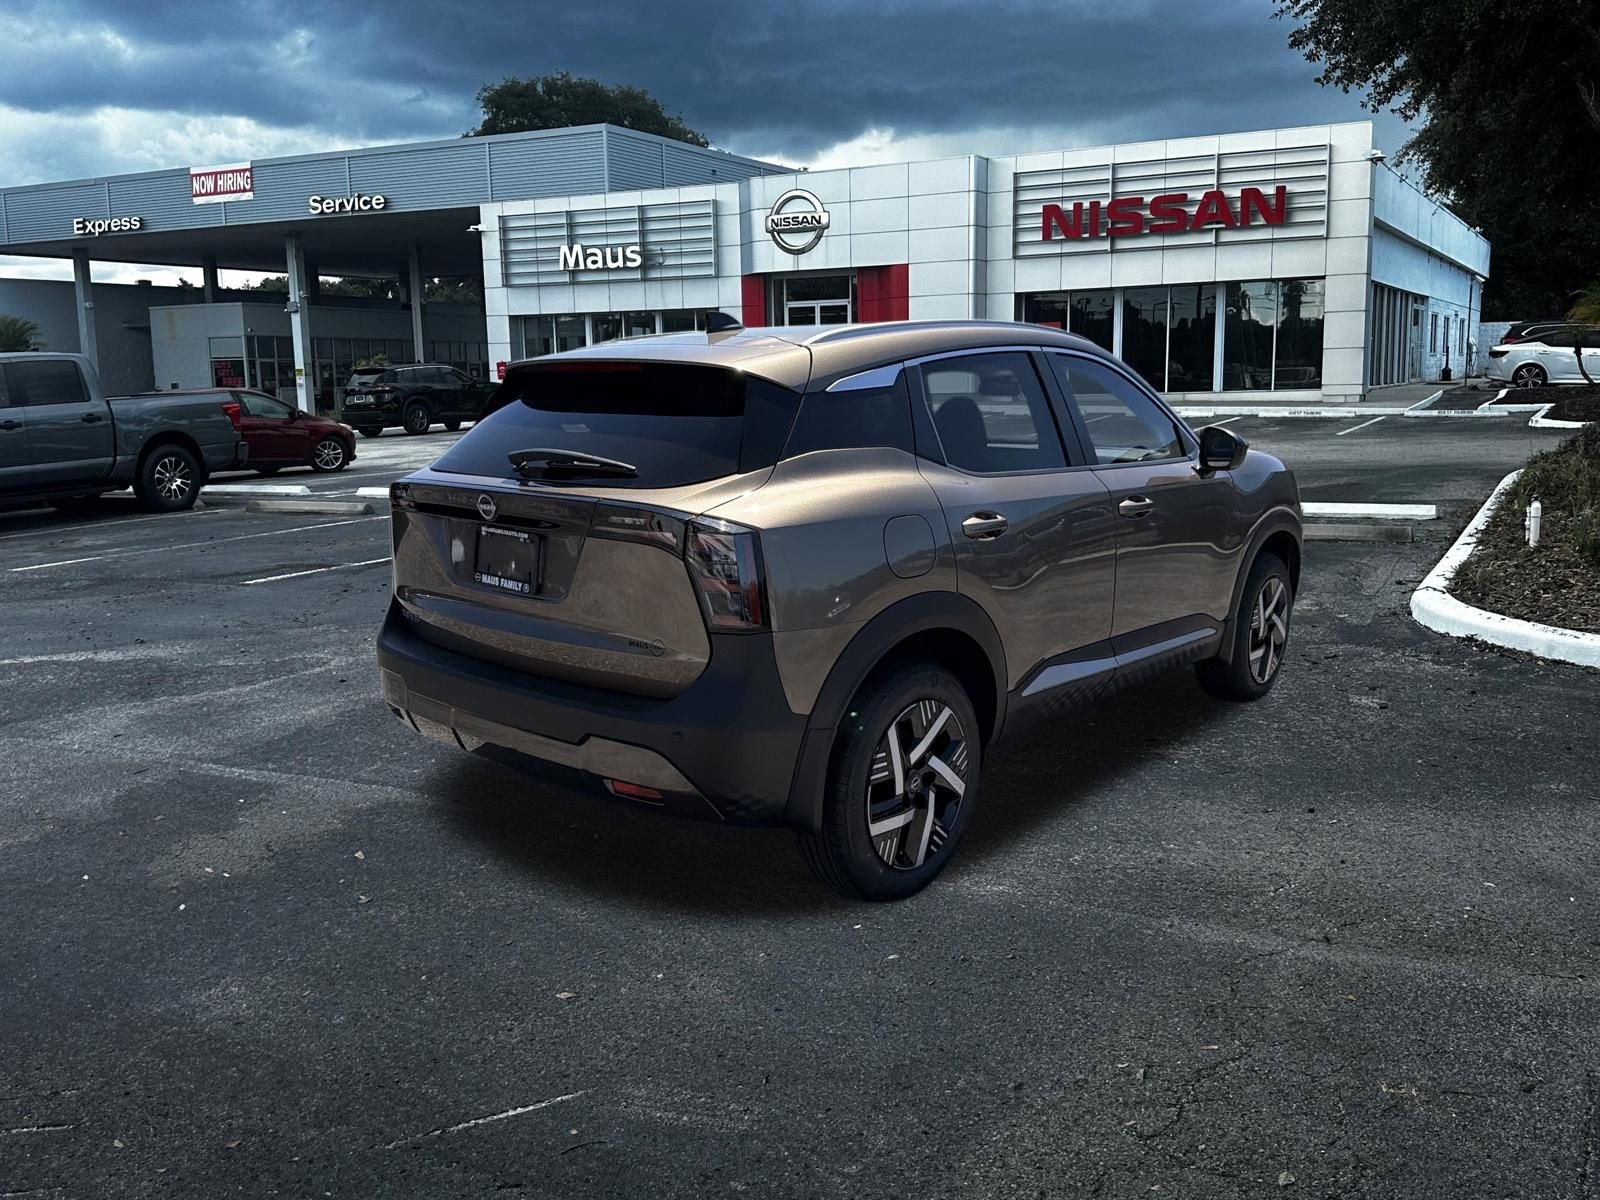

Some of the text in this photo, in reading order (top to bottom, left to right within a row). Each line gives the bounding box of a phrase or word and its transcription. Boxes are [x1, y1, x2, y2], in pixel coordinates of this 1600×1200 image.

[192, 168, 251, 196] NOW HIRING
[308, 193, 386, 215] Service
[1041, 185, 1287, 241] NISSAN
[72, 215, 142, 236] Express
[770, 213, 822, 229] NISSAN
[559, 243, 642, 271] Maus
[481, 574, 523, 591] MAUS FAMILY
[628, 640, 649, 649] MAUS
